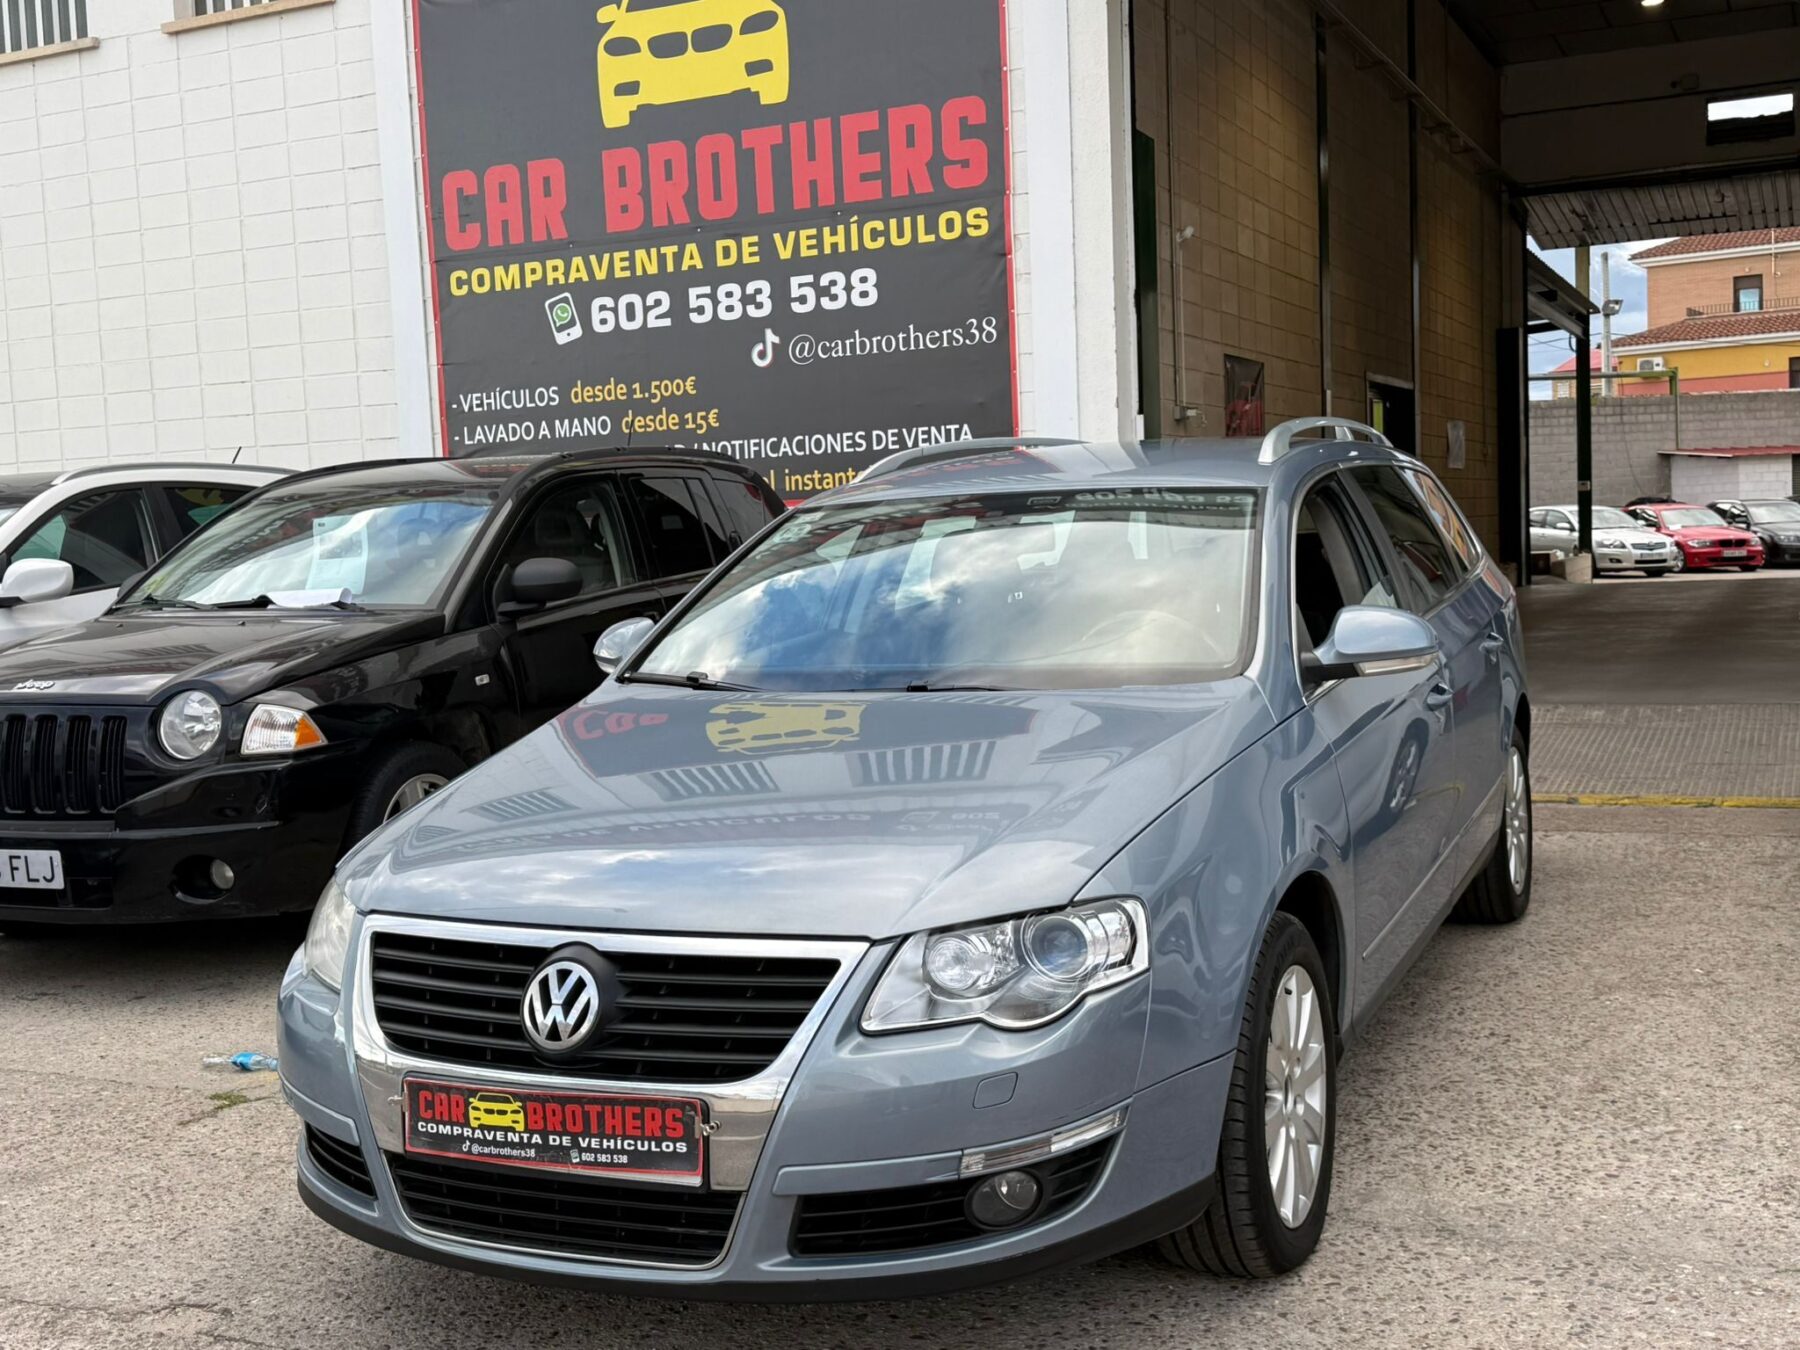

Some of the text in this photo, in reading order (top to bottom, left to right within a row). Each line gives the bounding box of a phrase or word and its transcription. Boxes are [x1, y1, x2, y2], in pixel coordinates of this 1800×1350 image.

[442, 95, 989, 250] CAR BROTHERS
[449, 207, 989, 297] COMPRAVENTA DE VEHÍCULOS
[590, 268, 878, 333] 602 583 538
[788, 316, 998, 365] @carbrothers38
[460, 386, 560, 413] VEHÍCULOS
[570, 377, 627, 404] desde
[632, 376, 697, 403] 1.500€
[464, 421, 535, 445] LAVADO
[538, 420, 551, 440] A
[555, 415, 611, 438] MANO
[621, 407, 680, 434] desde
[684, 408, 720, 434] 15€
[872, 429, 898, 451] DE
[901, 423, 974, 448] VENTA
[785, 467, 864, 491] instant
[9, 855, 55, 883] FLJ
[419, 1090, 684, 1138] CAR BROTHERS
[417, 1121, 688, 1153] COMPRAVENTA DE VEHÍCULOS
[471, 1143, 628, 1164] @carbrothers38 602 583 538
